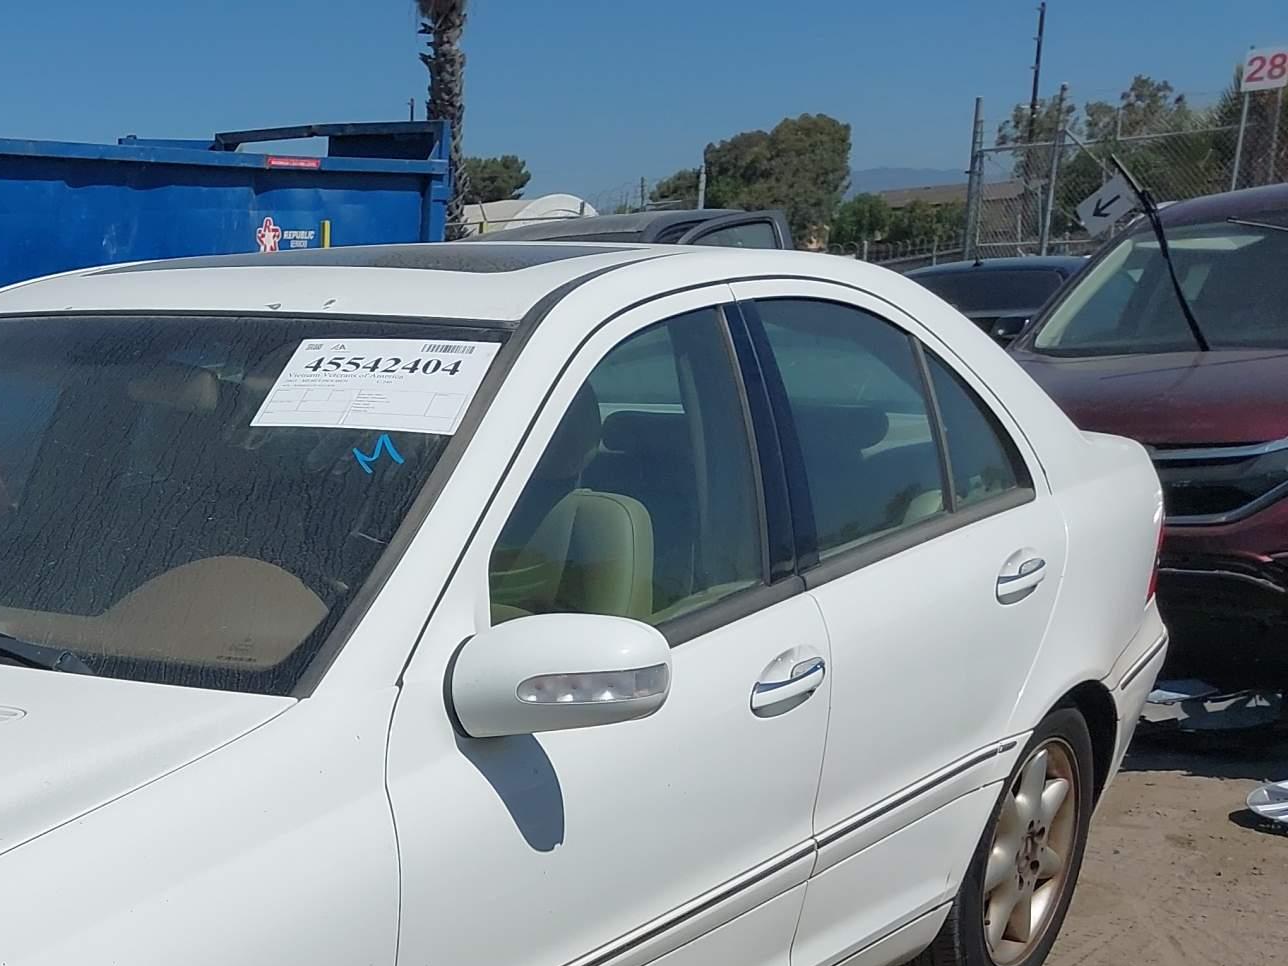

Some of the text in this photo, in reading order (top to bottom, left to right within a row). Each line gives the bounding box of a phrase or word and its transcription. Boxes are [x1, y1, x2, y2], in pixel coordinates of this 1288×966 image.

[1245, 53, 1287, 83] 28
[283, 230, 315, 240] REPUBLIC
[304, 356, 463, 376] 45542404
